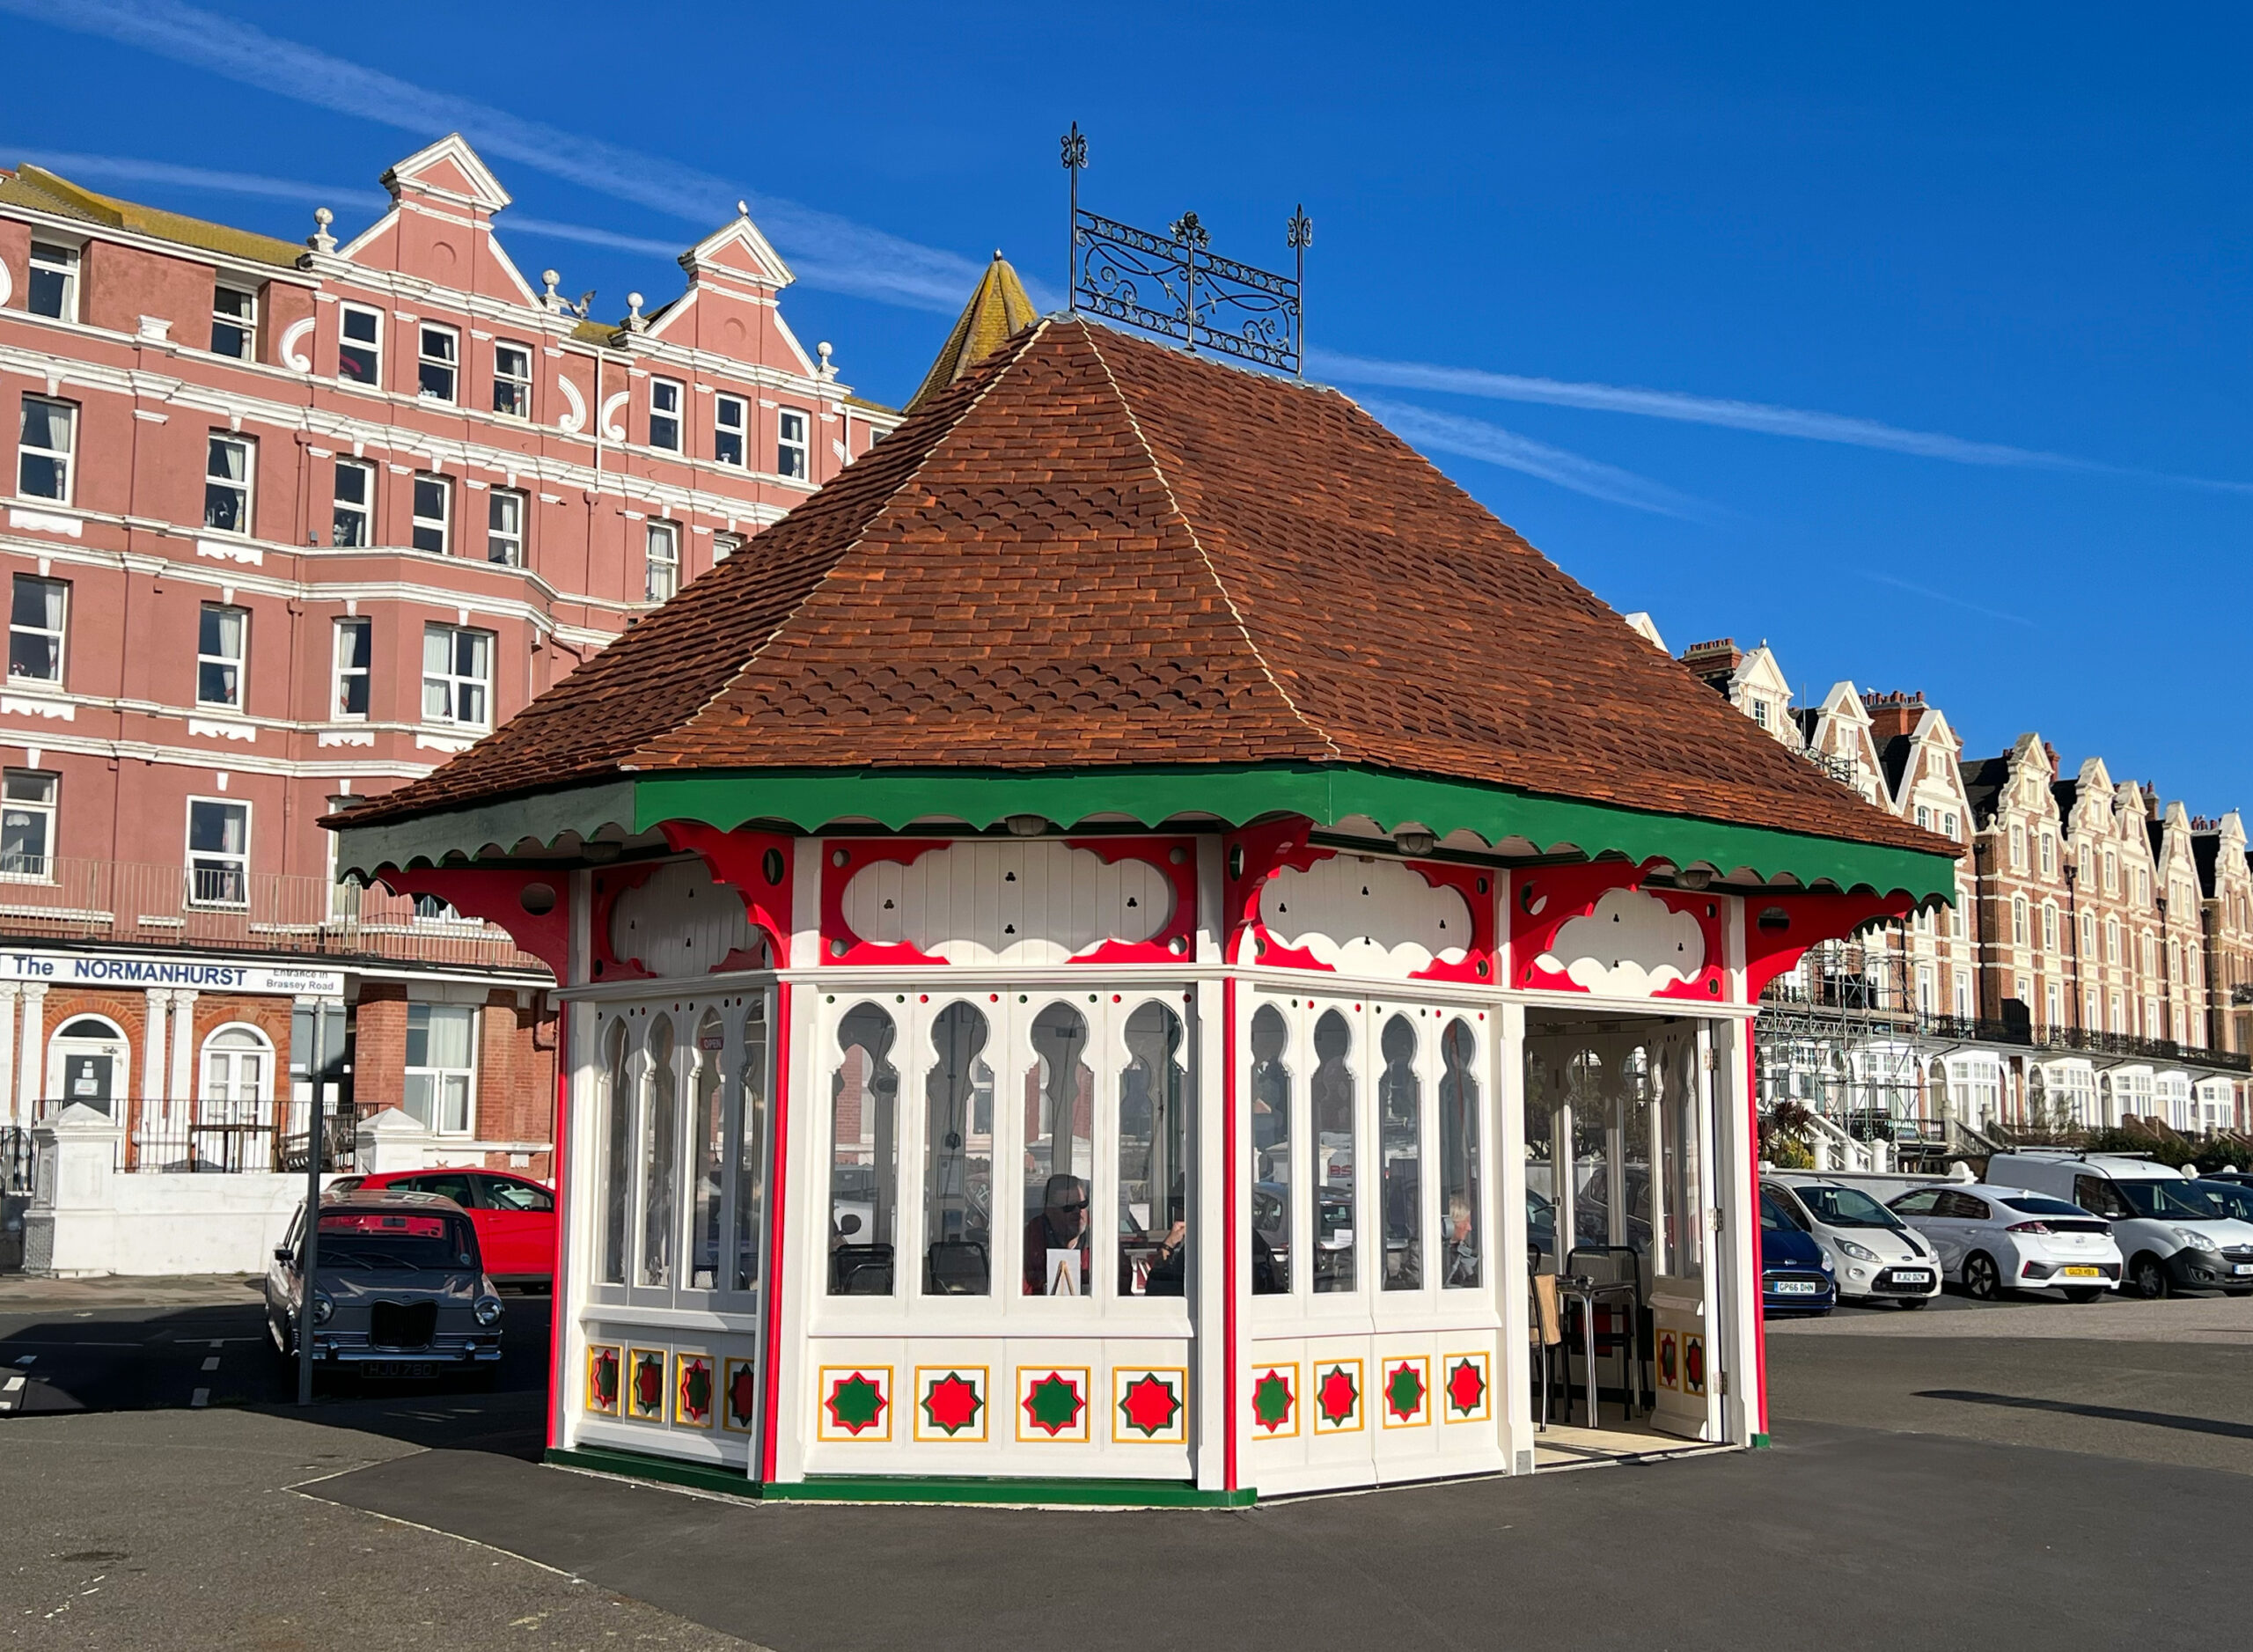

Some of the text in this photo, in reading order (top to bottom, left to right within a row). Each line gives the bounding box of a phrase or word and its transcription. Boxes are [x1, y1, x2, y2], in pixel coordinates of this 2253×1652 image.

[13, 956, 247, 986] The NORMANHURST
[273, 969, 317, 979] Entrance
[267, 980, 334, 991] Brassey Road
[704, 1039, 722, 1049] OPEN
[370, 1363, 399, 1376] HJU
